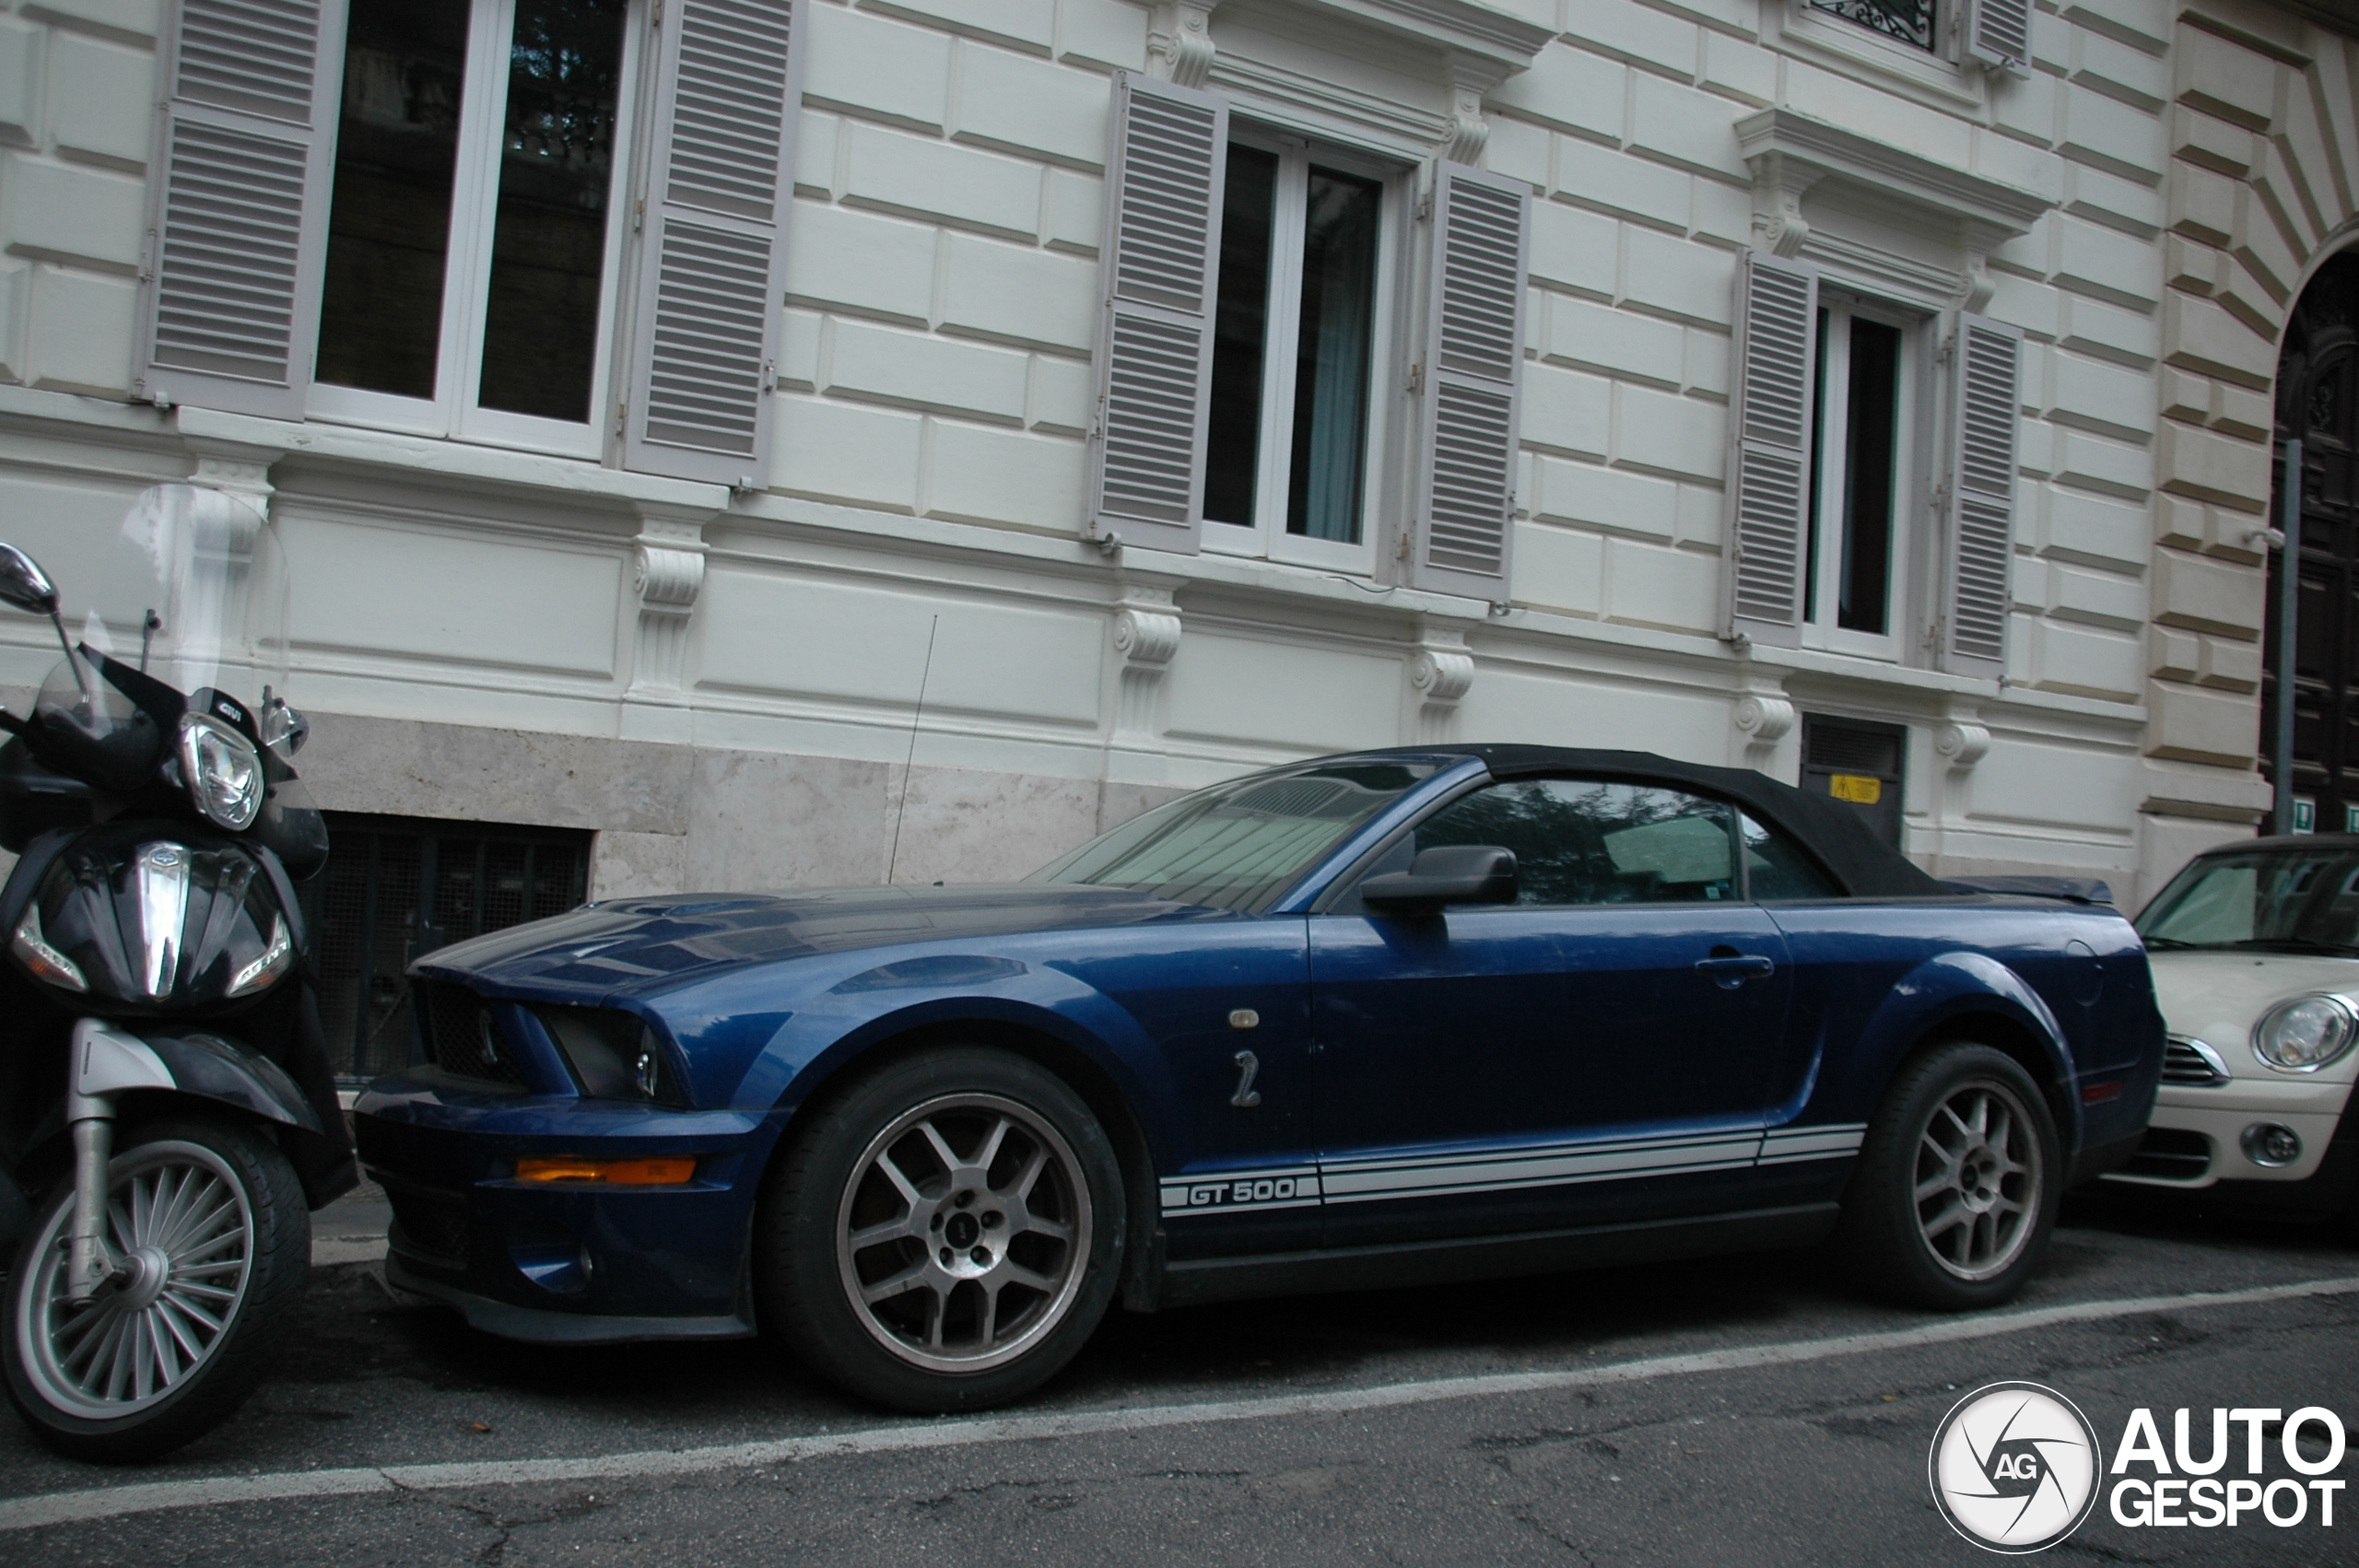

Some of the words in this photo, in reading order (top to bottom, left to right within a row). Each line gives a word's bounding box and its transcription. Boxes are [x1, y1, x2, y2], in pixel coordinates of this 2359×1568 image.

[219, 702, 242, 722] GIVI
[1190, 1183, 1230, 1205] GT
[1233, 1178, 1296, 1202] 500
